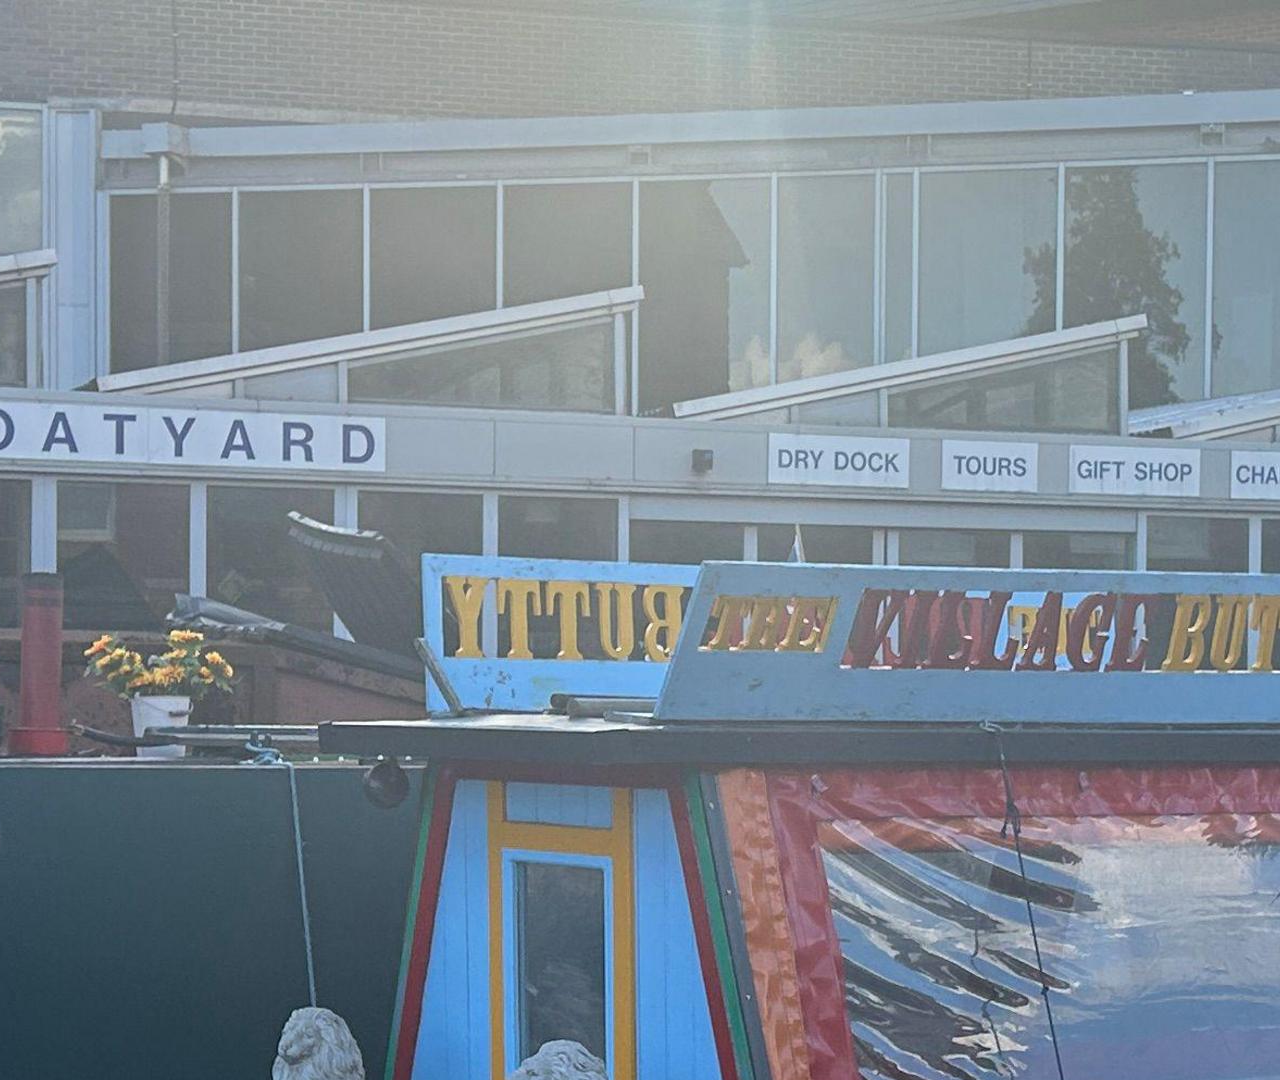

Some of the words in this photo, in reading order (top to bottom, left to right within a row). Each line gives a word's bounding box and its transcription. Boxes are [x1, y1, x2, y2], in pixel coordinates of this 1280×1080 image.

[778, 449, 824, 470] DRY
[834, 451, 900, 473] DOCK
[954, 455, 1027, 477] TOURS
[1077, 460, 1125, 480] GIFT
[1134, 462, 1193, 482] SHOP
